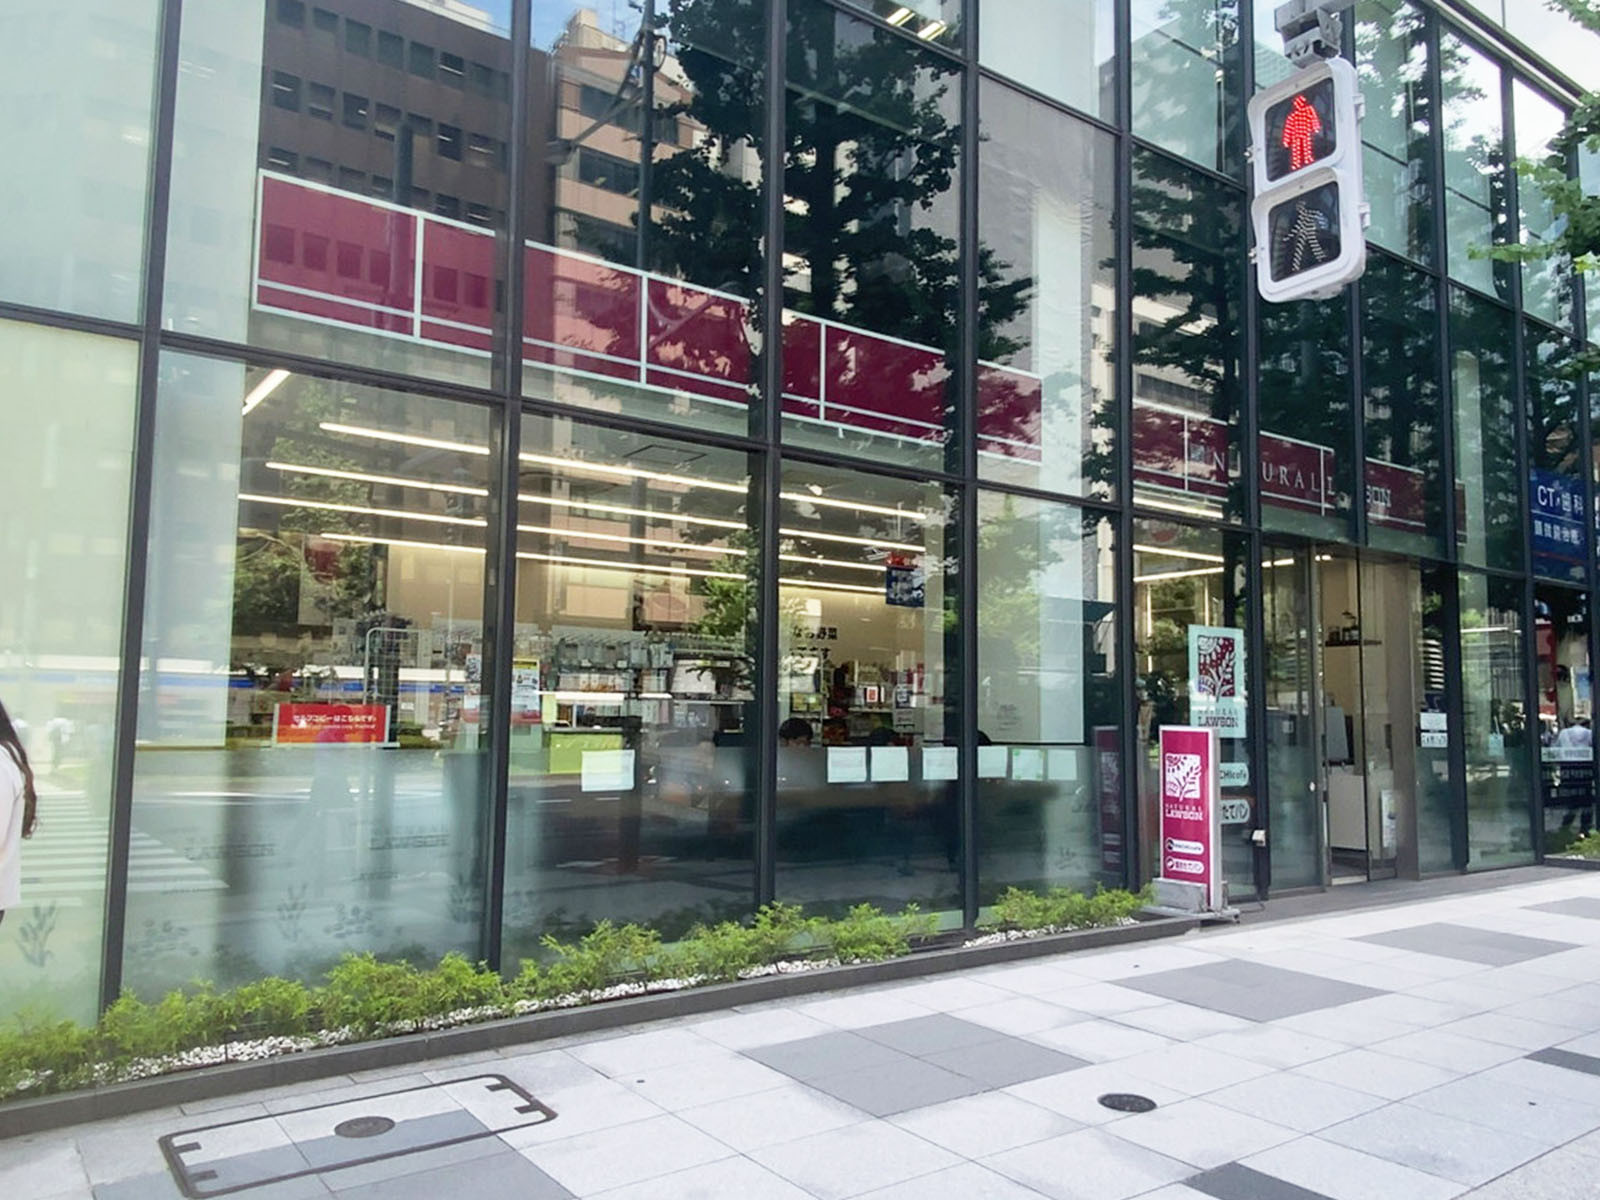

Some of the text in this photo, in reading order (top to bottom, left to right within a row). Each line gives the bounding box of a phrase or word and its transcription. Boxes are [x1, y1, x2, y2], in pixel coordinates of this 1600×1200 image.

[1213, 452, 1319, 492] NURAL
[1197, 715, 1239, 728] LAWSON
[1165, 808, 1204, 821] LAWSON
